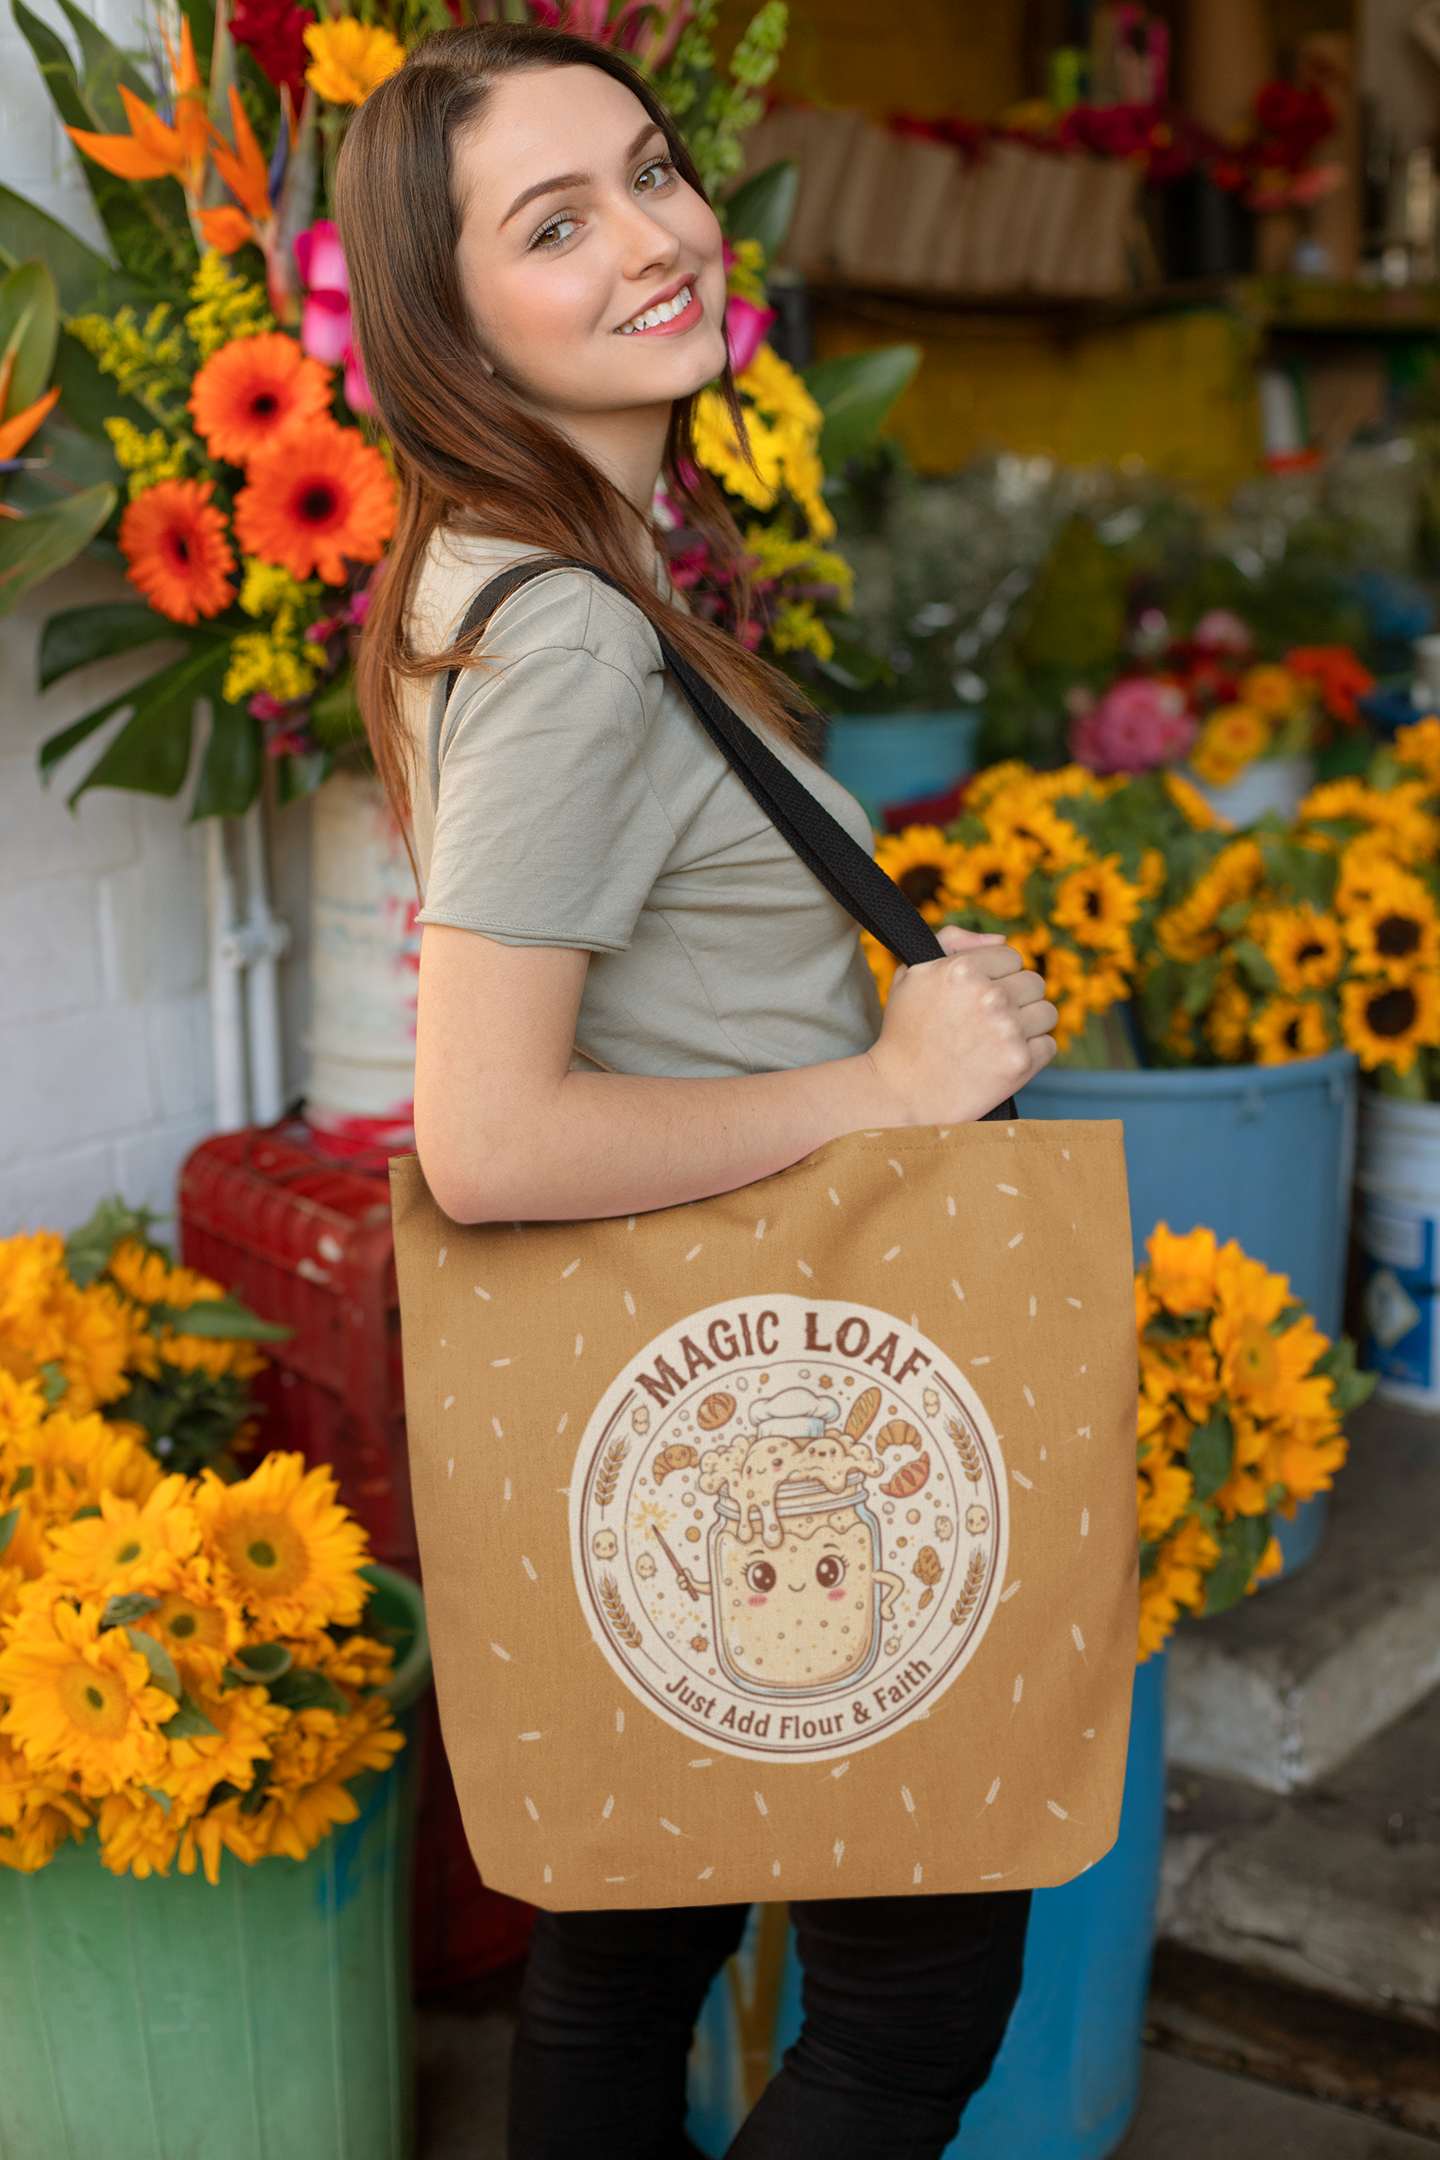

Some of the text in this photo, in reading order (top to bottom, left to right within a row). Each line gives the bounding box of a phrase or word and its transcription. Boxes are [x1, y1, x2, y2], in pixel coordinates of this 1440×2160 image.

[634, 1310, 932, 1409] MAGIC LOAF
[665, 1659, 932, 1739] Just Add Flour & Faith
